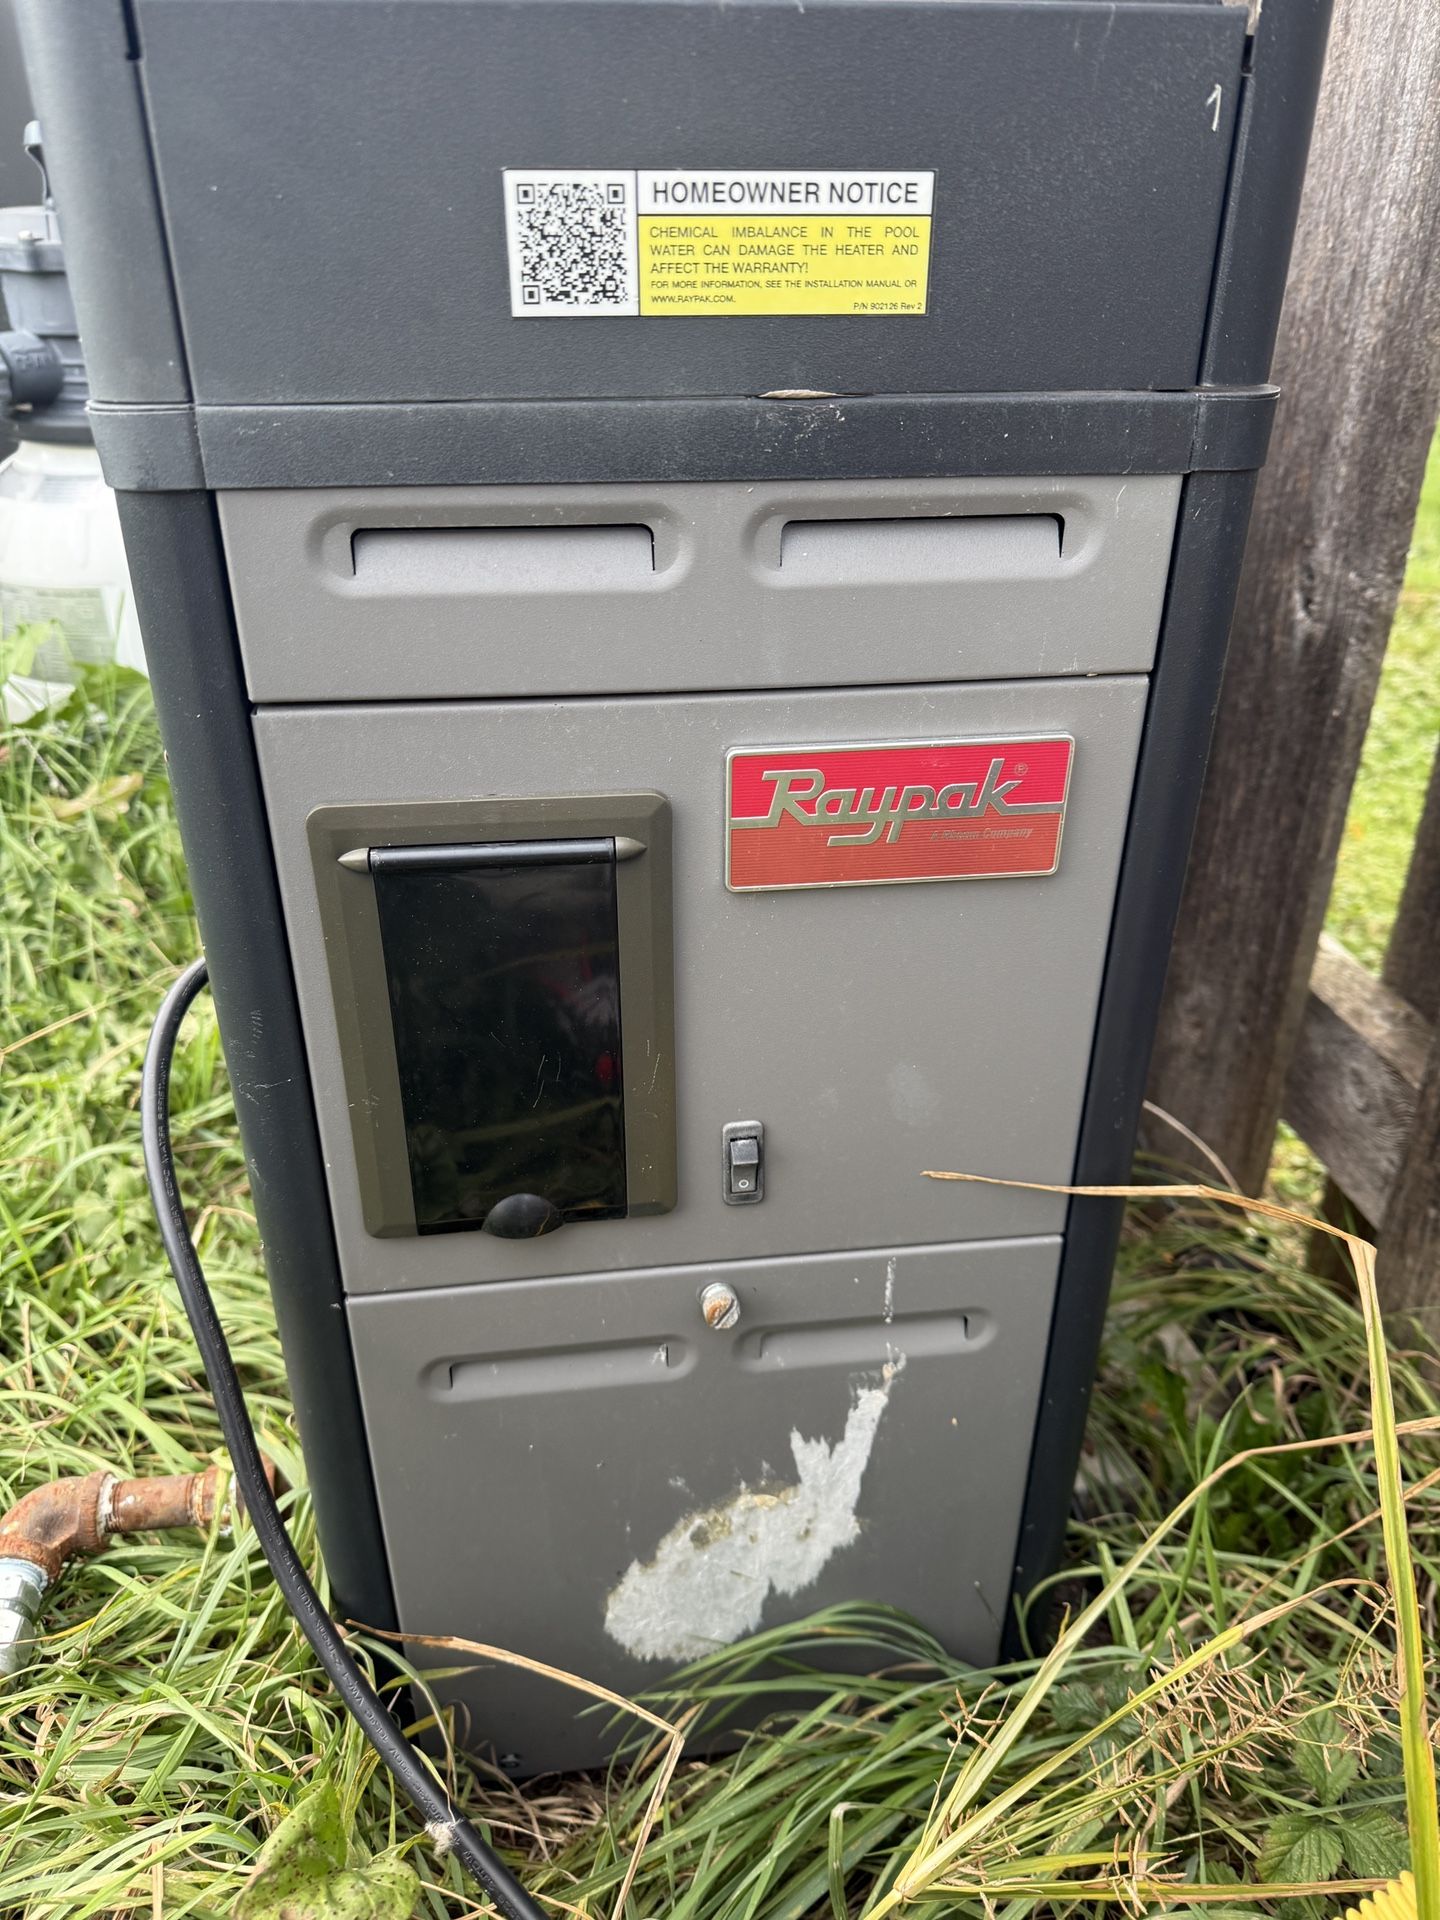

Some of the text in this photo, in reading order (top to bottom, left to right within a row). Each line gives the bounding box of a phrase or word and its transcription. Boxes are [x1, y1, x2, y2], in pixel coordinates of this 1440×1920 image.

[652, 181, 919, 204] HOMEOWNER NOTICE
[649, 225, 920, 239] CHEMICAL IMBALANCE IN THE POOL
[650, 243, 919, 257] WATER CAN DAMAGE THE HEATER AND
[650, 261, 809, 275] AFFECT THE WARRANTY!
[651, 279, 918, 291] FOR MORE INFORMATION, SEE THE INSTALLATION MANUAL OR
[853, 301, 923, 311] P/N 902126 Rev 2
